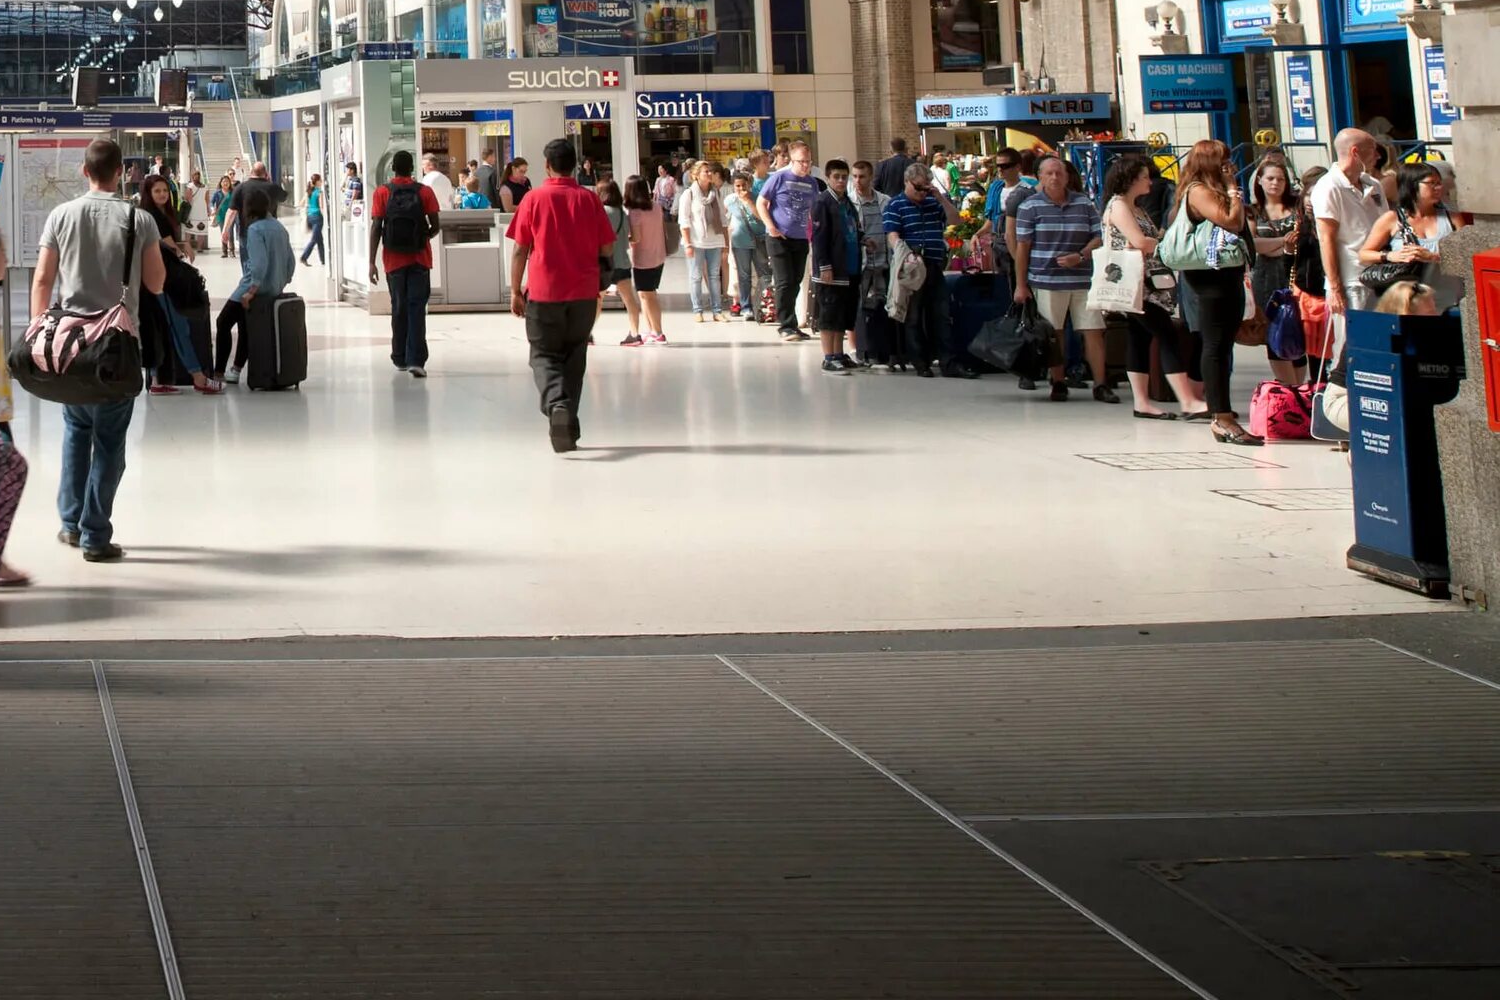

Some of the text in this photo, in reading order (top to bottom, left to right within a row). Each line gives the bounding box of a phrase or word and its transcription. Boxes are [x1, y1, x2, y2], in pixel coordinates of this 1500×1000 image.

[537, 7, 557, 16] NEW
[566, 0, 598, 13] WIN
[598, 8, 630, 18] HOUR
[1147, 63, 1225, 76] CASH MACHINE
[508, 66, 601, 89] swatch
[1151, 88, 1171, 97] Free
[636, 93, 714, 118] Smith
[923, 104, 989, 119] NERO EXPRESS
[1030, 99, 1094, 115] NERO
[1185, 101, 1202, 109] VISA
[11, 116, 32, 125] Platforms
[46, 116, 57, 126] only
[702, 137, 737, 152] FREE
[1418, 363, 1450, 374] METRO
[1361, 398, 1387, 413] METRO
